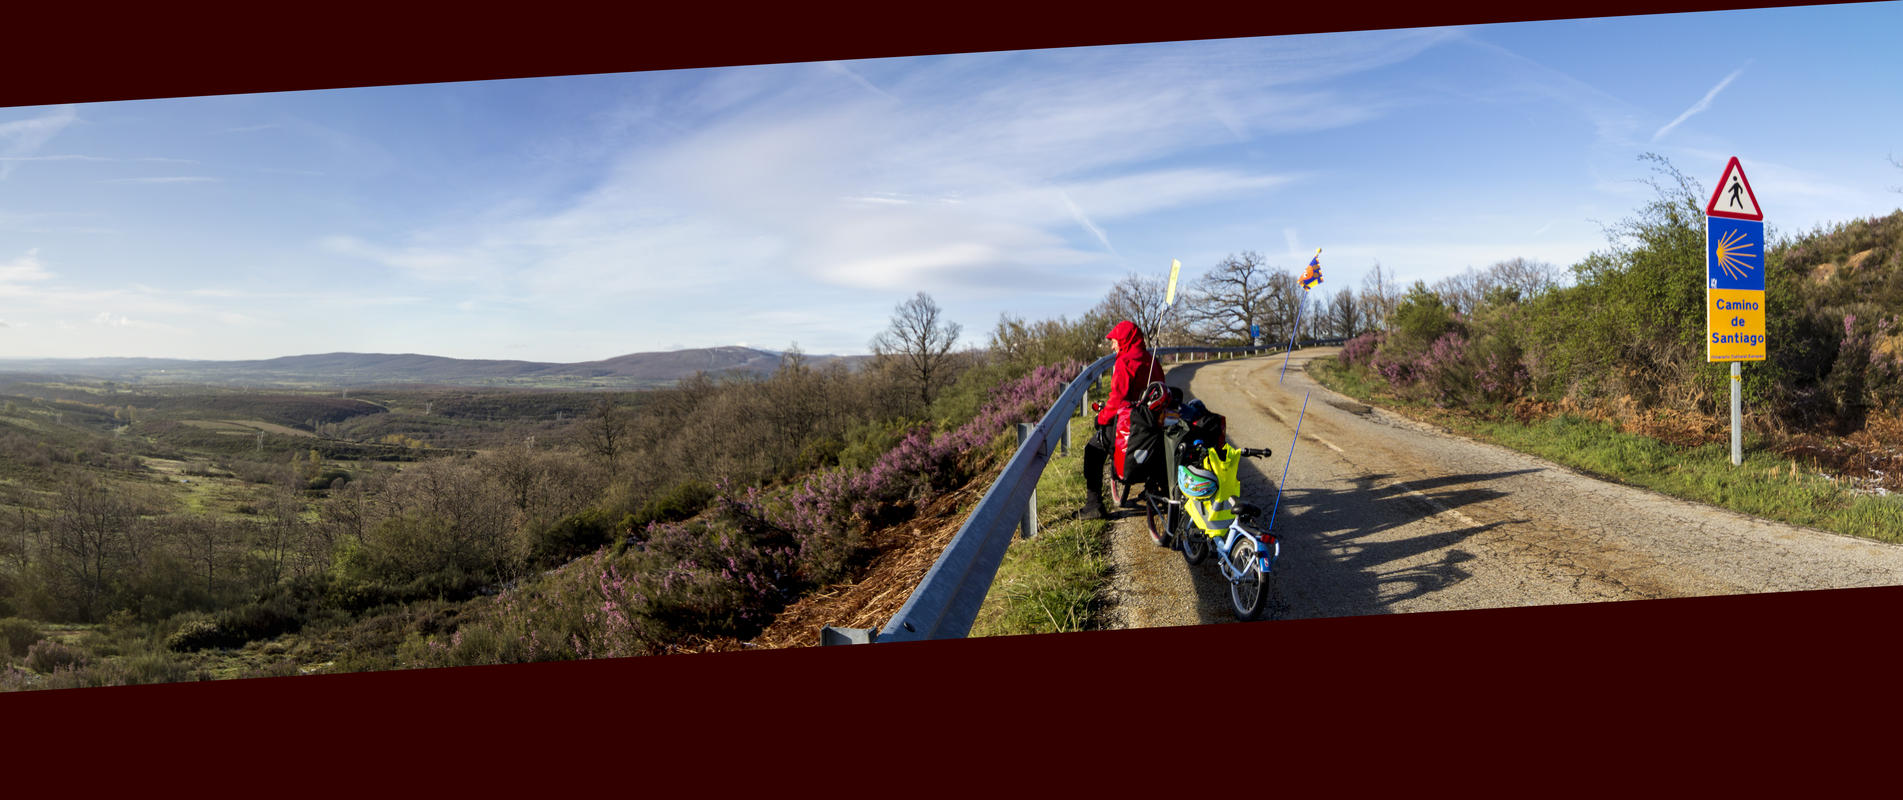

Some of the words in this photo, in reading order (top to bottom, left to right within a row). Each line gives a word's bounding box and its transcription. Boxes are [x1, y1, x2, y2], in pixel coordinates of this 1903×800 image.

[1716, 298, 1759, 311] Camino
[1731, 316, 1745, 327] de
[1712, 332, 1764, 346] Santiago
